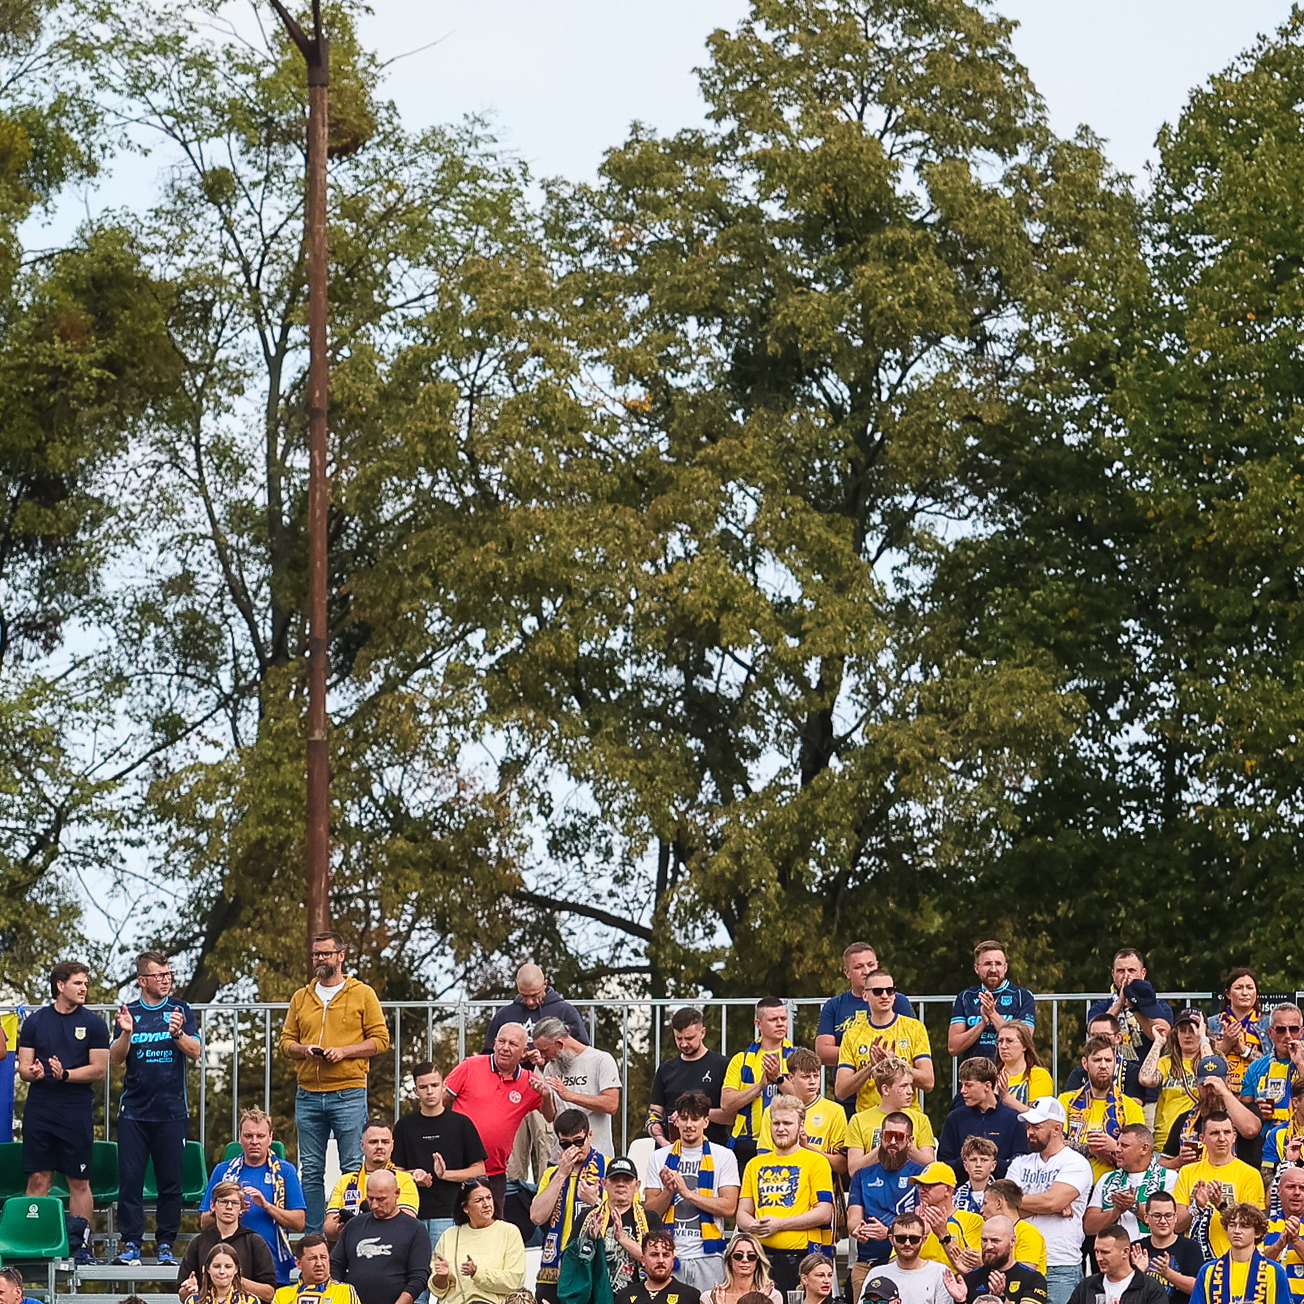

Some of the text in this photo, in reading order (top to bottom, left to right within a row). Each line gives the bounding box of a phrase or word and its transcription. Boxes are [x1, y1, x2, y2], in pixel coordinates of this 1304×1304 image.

[146, 1048, 173, 1058] Energa
[565, 1075, 587, 1087] asics
[760, 1183, 792, 1194] ARKA
